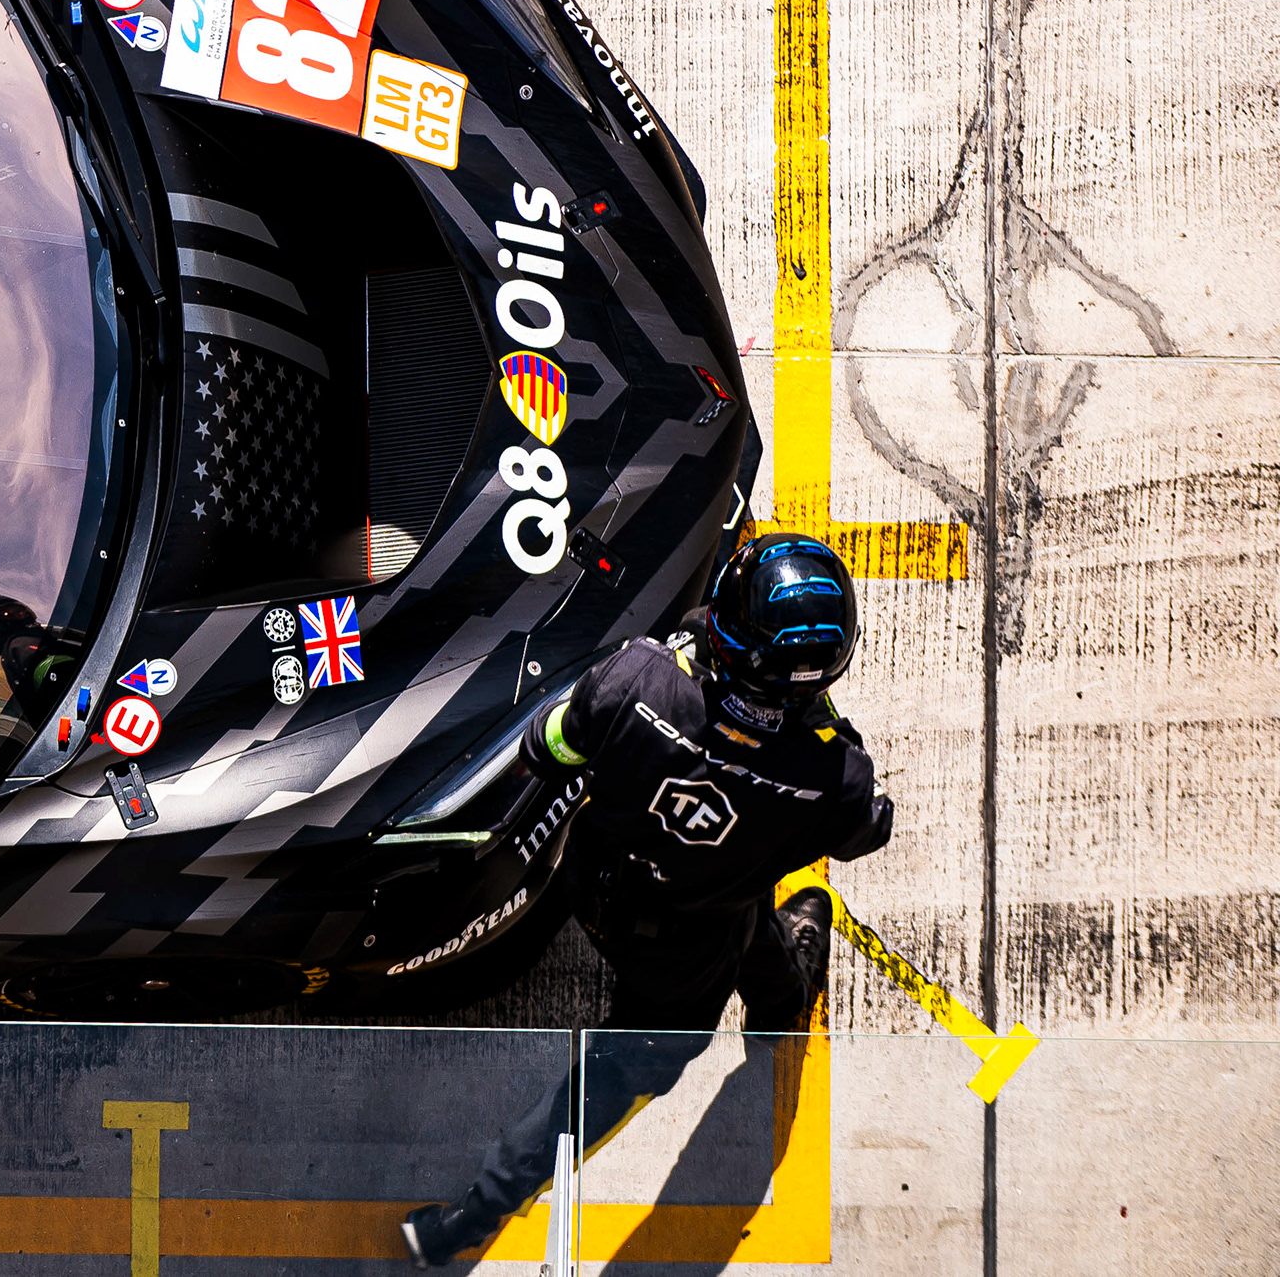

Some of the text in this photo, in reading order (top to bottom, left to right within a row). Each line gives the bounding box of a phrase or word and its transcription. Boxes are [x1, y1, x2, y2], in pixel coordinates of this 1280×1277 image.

[140, 25, 159, 42] N
[373, 74, 413, 132] LM
[414, 81, 454, 151] GT3
[495, 182, 569, 575] Q8 Oils
[151, 670, 169, 684] N
[111, 705, 155, 747] E
[634, 701, 823, 801] CORVETTE
[671, 792, 721, 830] TF
[386, 887, 528, 975] GOODYEAR
